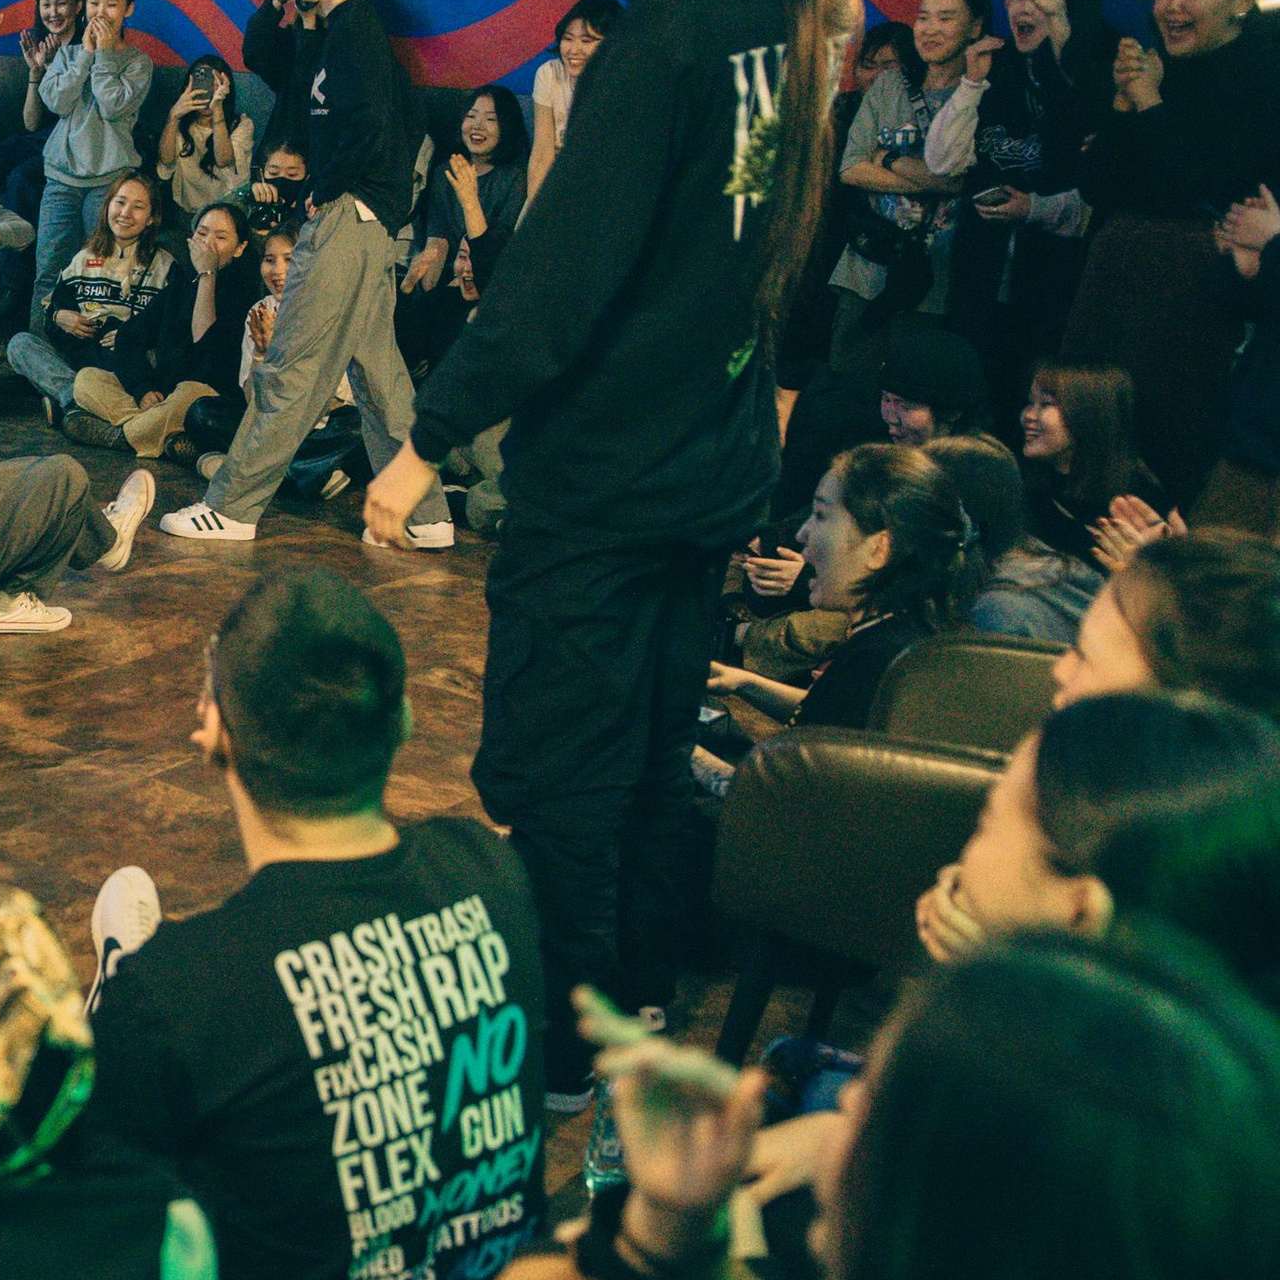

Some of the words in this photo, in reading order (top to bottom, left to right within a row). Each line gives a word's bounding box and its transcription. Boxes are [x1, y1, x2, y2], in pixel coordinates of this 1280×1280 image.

[274, 912, 415, 1006] CRASH
[403, 893, 493, 958] TRASH
[294, 965, 428, 1060] FRESH
[421, 930, 510, 1030] RAP
[313, 1060, 361, 1102] FIX
[350, 1010, 444, 1090] CASH
[441, 1003, 527, 1133] NO
[323, 1068, 436, 1158] ZONE
[460, 1083, 526, 1160] GUN
[336, 1127, 442, 1212] FLEX
